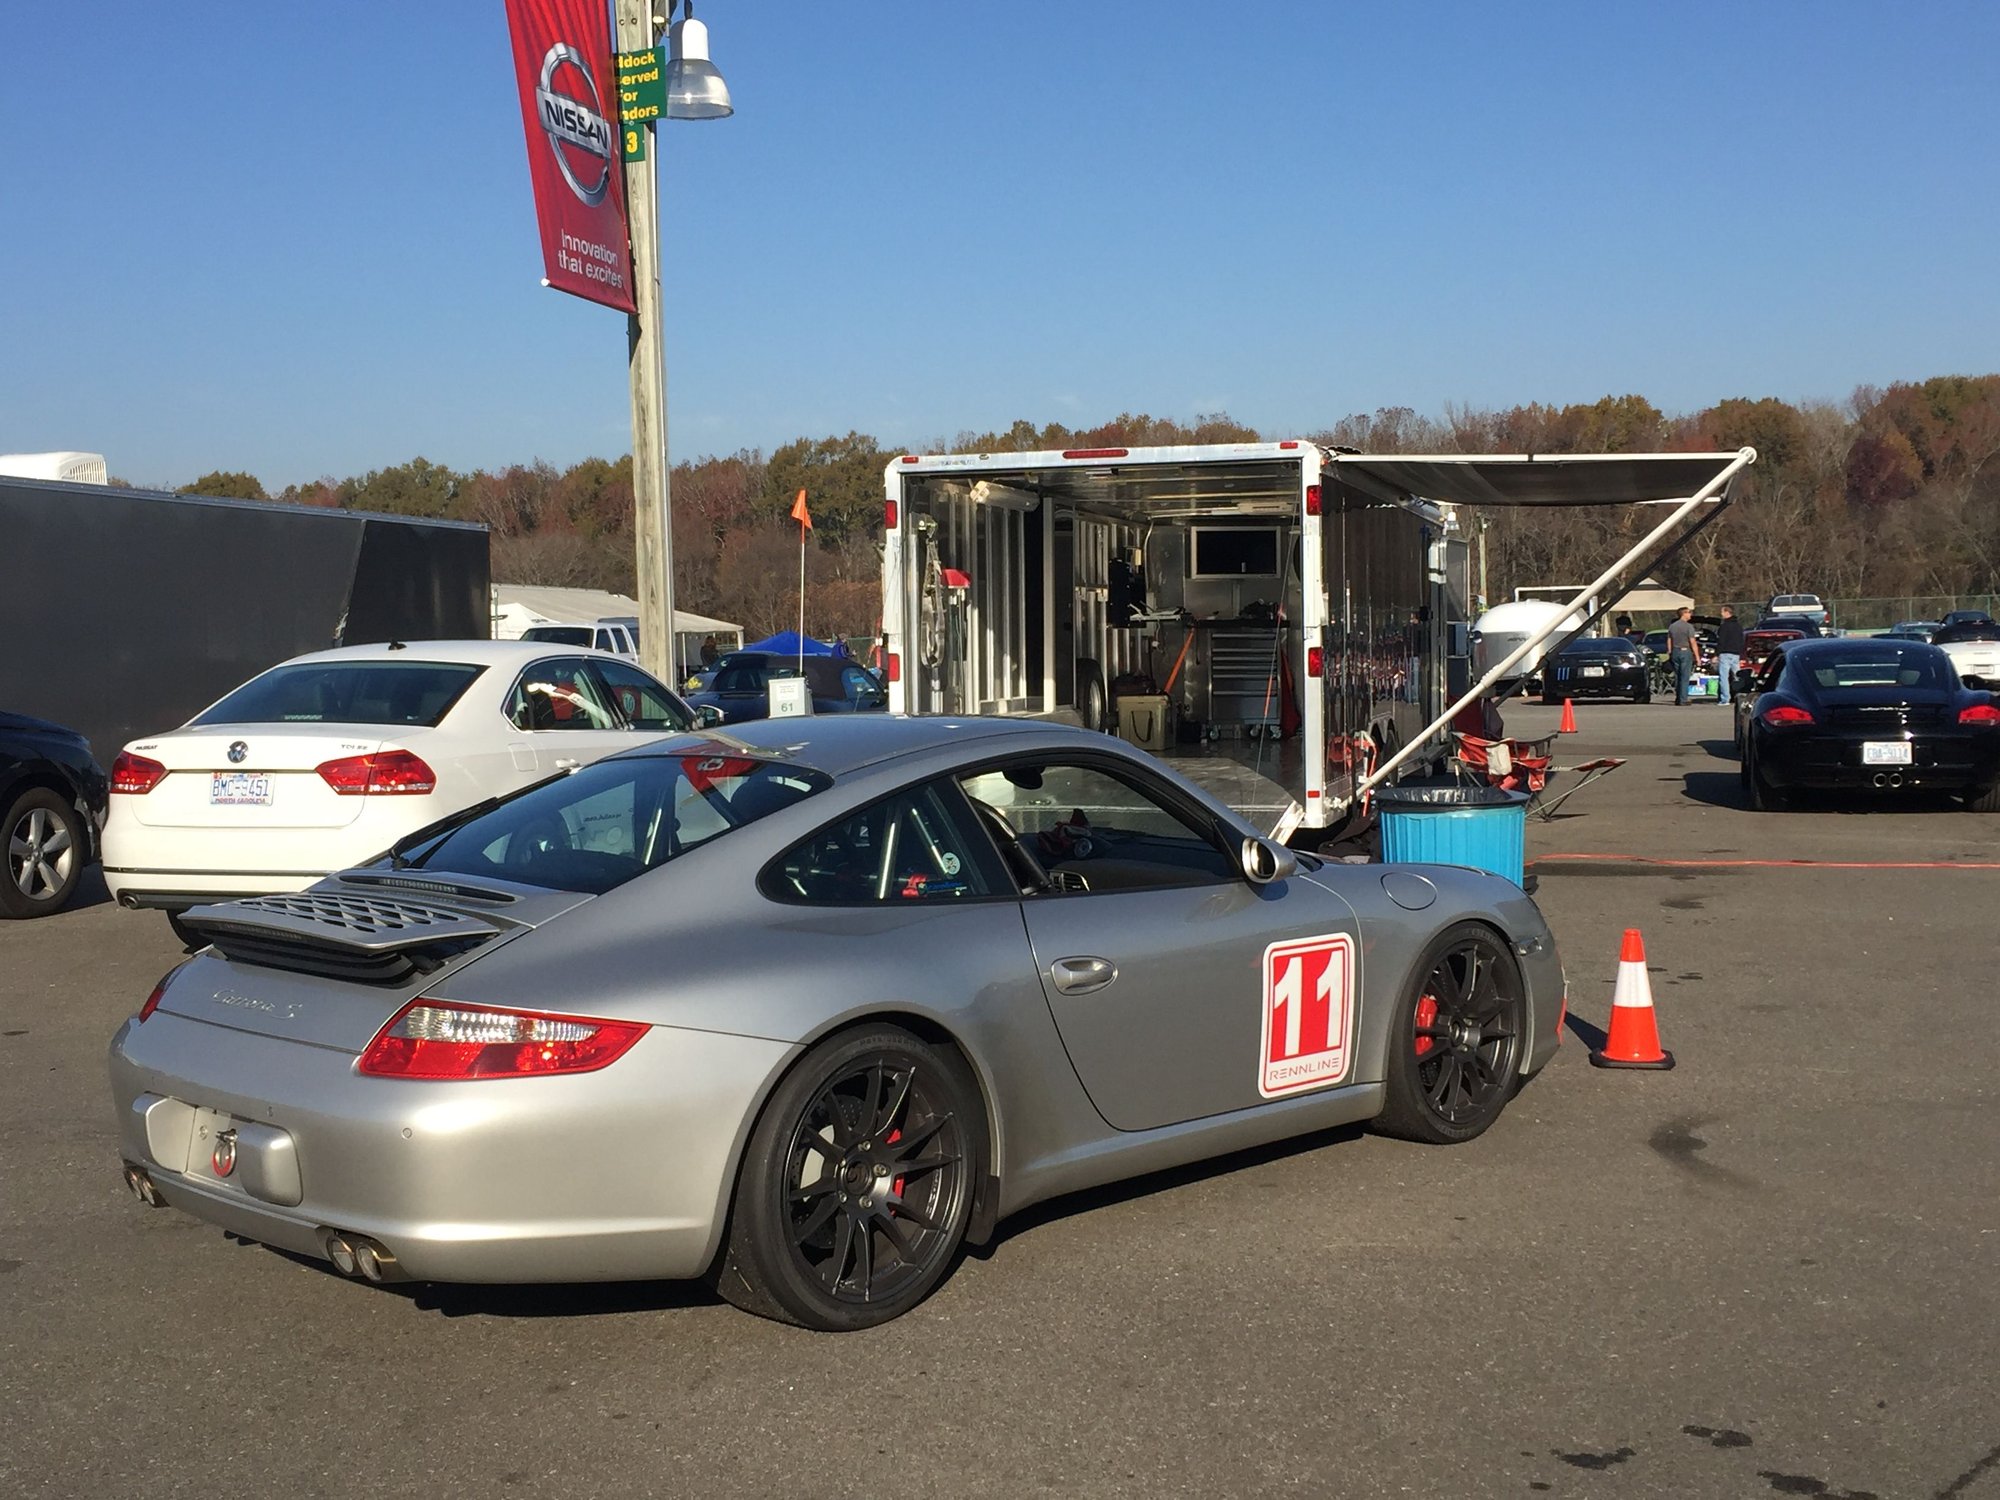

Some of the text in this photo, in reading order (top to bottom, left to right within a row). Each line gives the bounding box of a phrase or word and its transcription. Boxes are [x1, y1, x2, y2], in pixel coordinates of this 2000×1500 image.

[545, 99, 608, 150] NISSAN
[621, 105, 659, 120] ndors
[626, 131, 638, 153] 3
[561, 228, 619, 267] Innovation
[558, 250, 623, 288] that excites
[780, 702, 793, 712] 61
[212, 779, 269, 797] BMC-9451
[1273, 949, 1344, 1057] 11
[1269, 1057, 1340, 1081] RENNLINE
